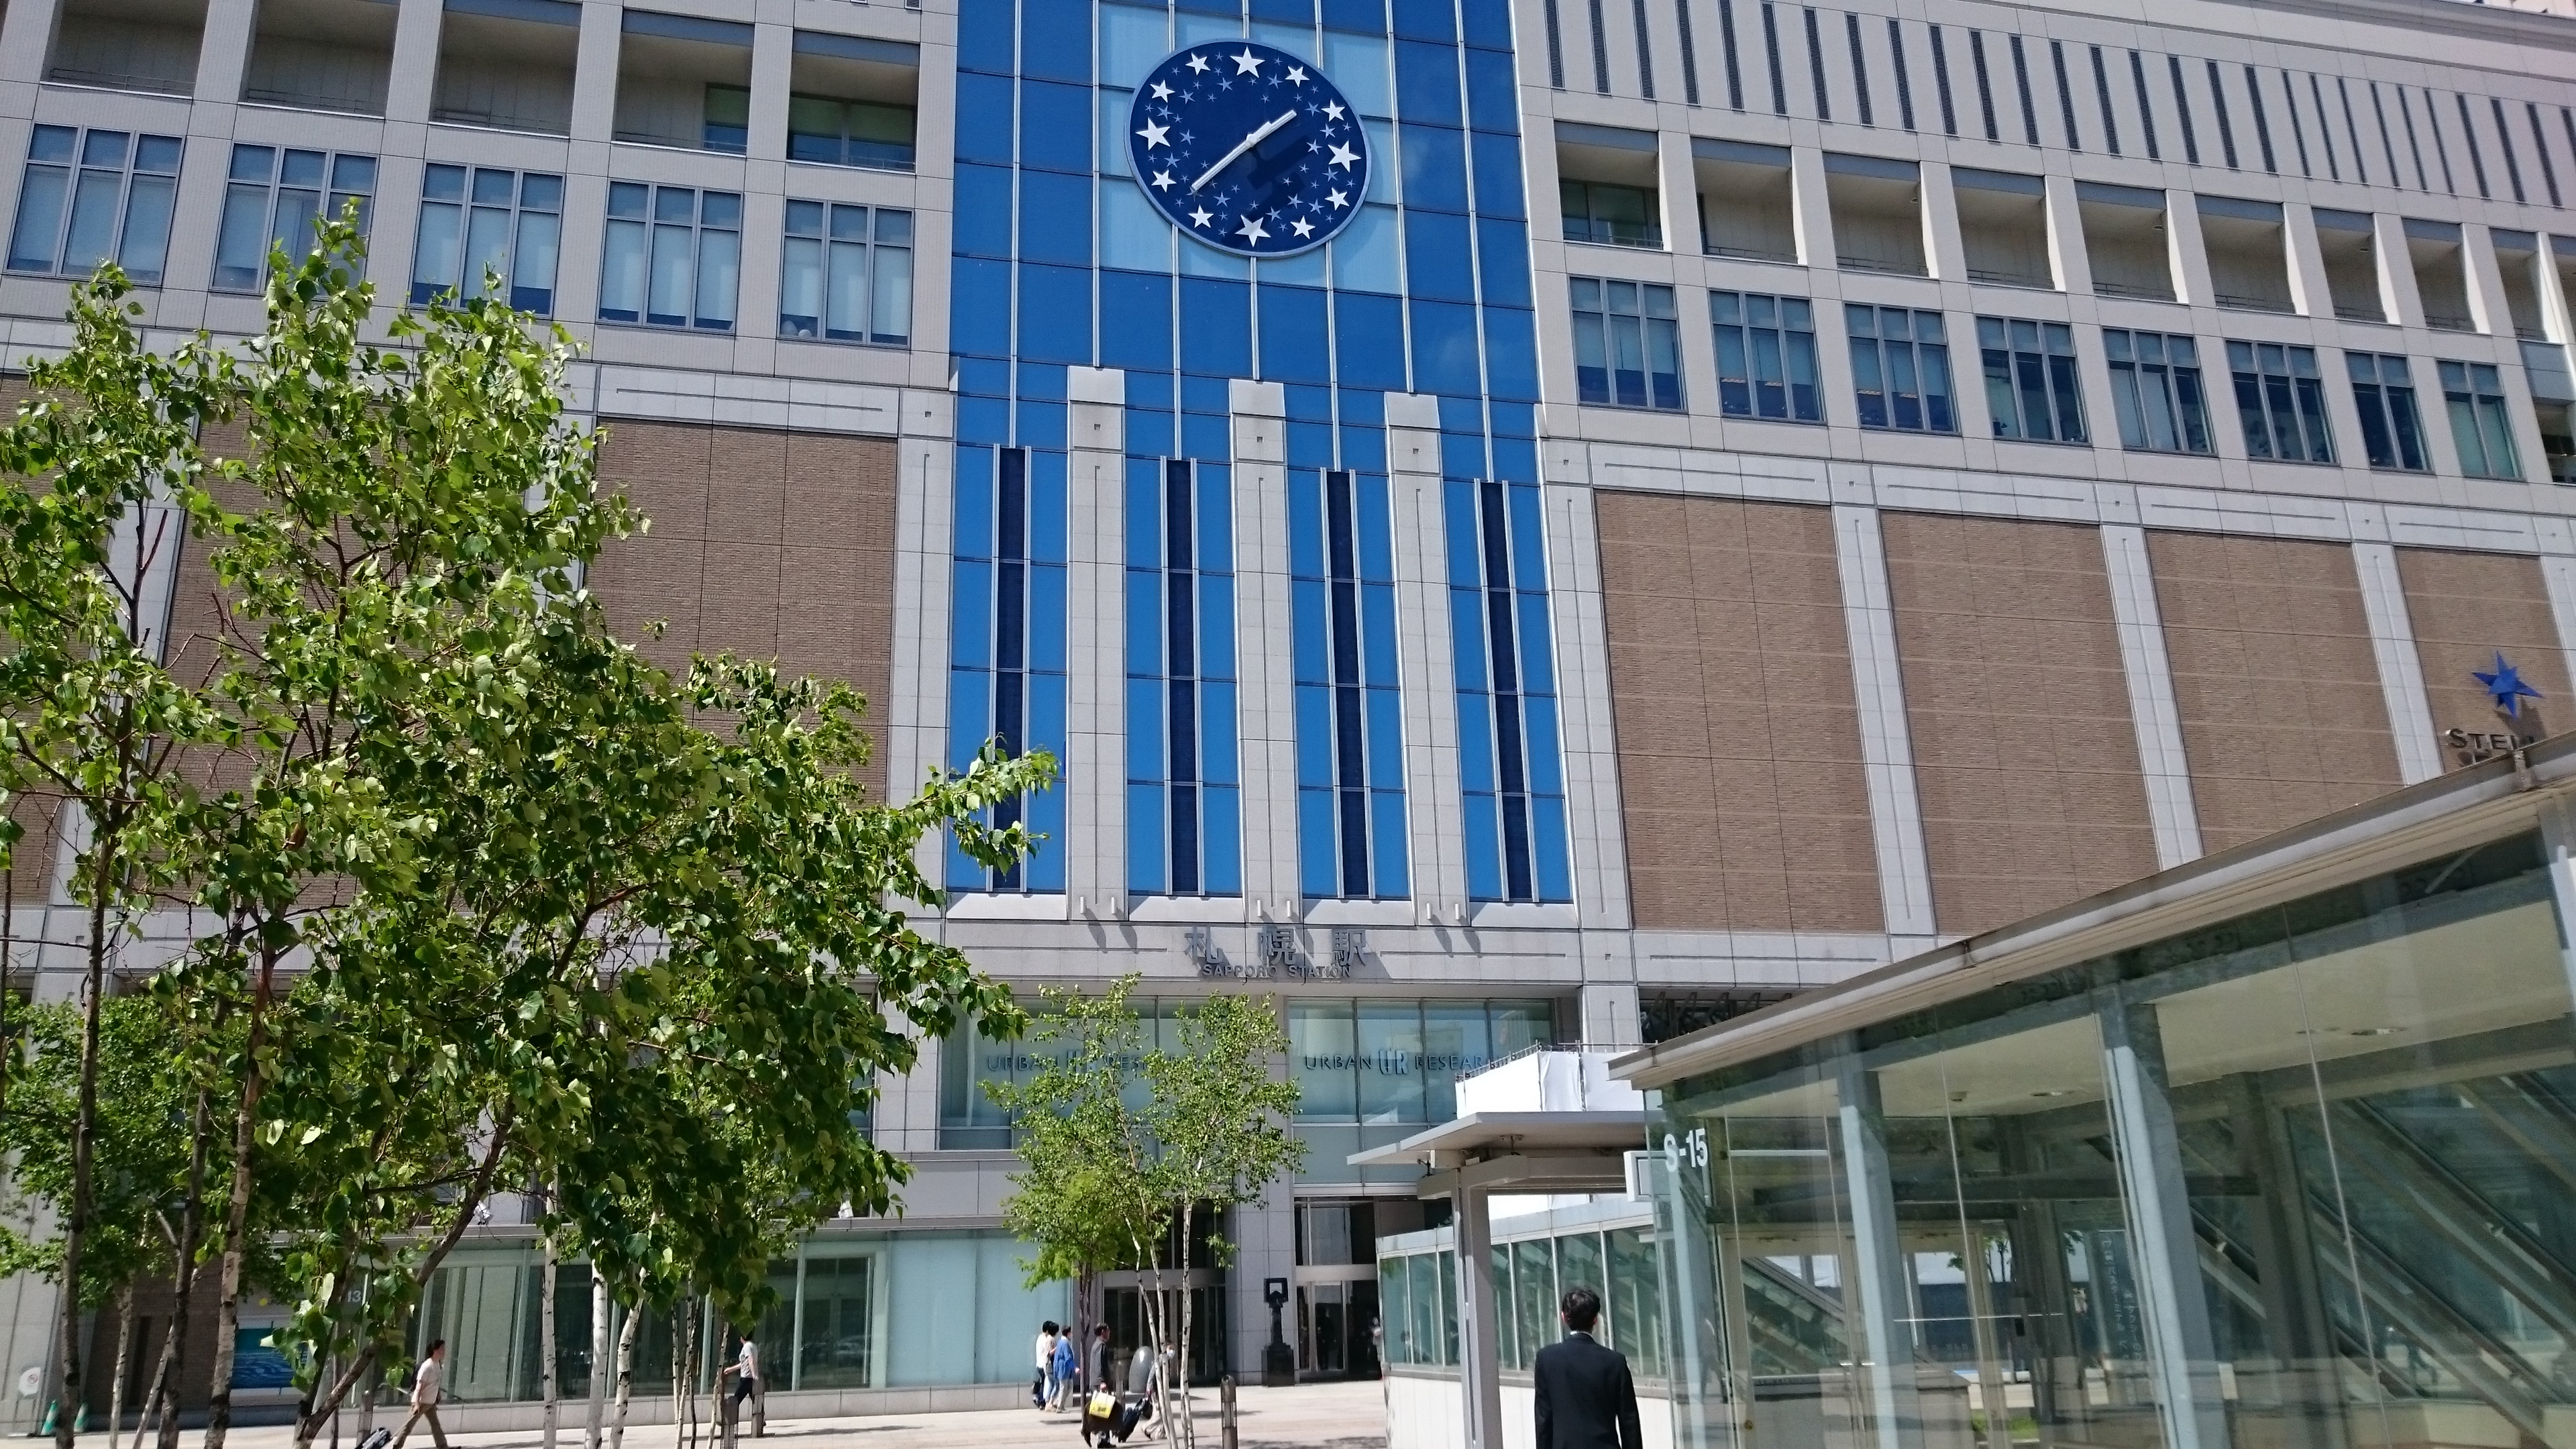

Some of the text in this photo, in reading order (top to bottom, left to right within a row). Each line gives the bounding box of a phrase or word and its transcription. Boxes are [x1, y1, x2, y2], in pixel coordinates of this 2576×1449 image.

[1184, 926, 1366, 966] 札幌駅
[1203, 965, 1351, 979] SAPPORO STATION
[1305, 1049, 1493, 1075] URBAN UR RESEAR
[1664, 1128, 1708, 1172] S-15
[347, 1290, 362, 1303] 13
